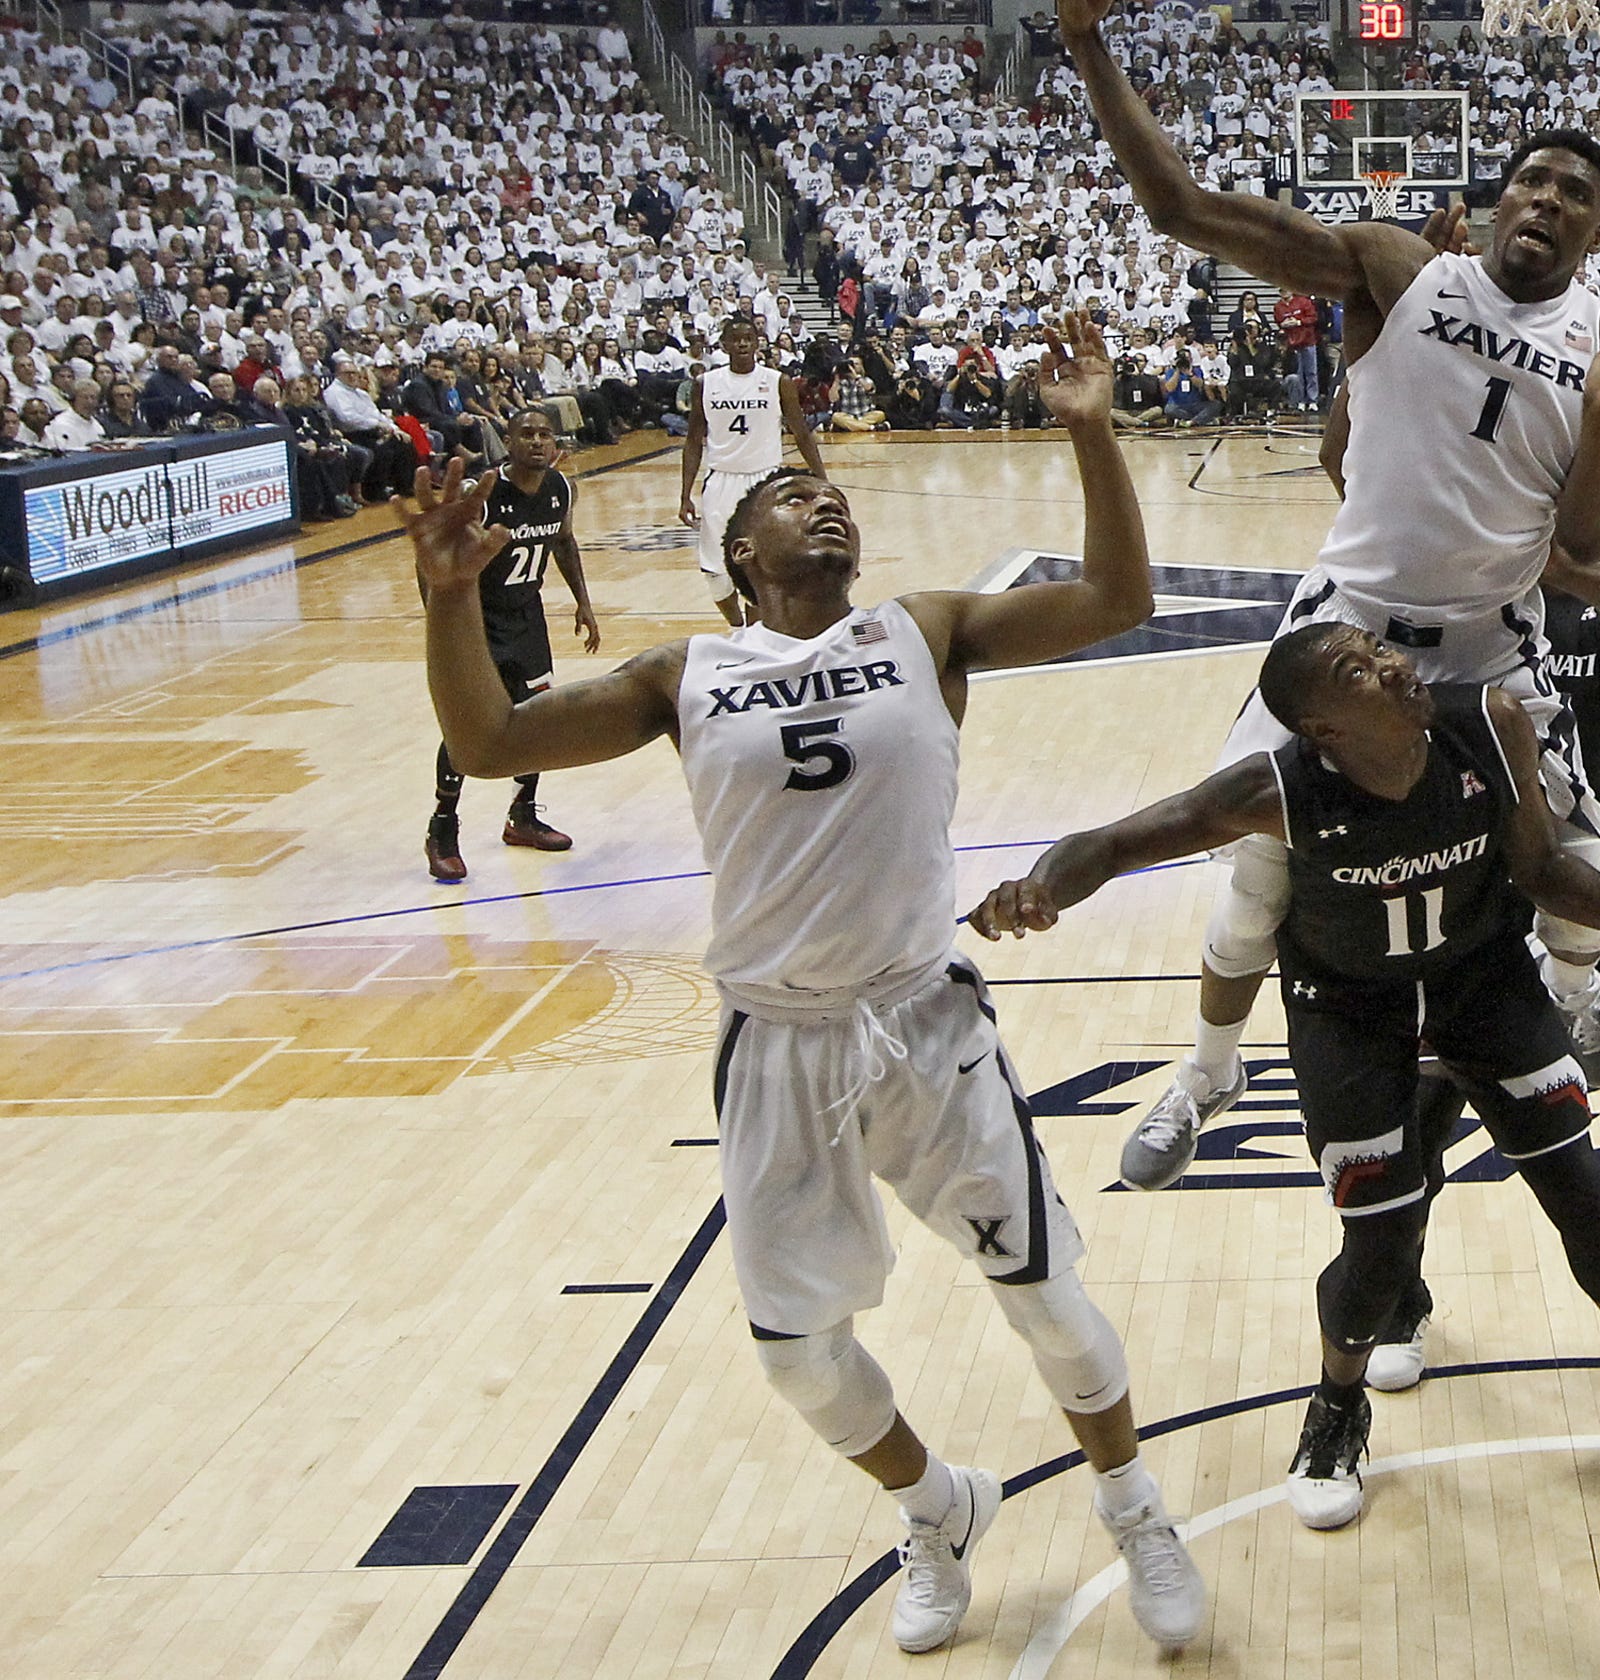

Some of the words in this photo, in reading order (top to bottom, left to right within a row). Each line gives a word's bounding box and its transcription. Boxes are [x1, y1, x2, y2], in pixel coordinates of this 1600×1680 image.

[1360, 4, 1403, 38] 30
[1302, 191, 1438, 212] XAVER
[1418, 308, 1586, 393] XAVIER
[710, 399, 769, 410] XAVIER
[728, 414, 749, 435] 4
[1468, 376, 1514, 444] 1
[62, 461, 210, 541] Woodhull
[219, 481, 286, 517] RICOH
[500, 521, 562, 540] NCINNATI
[504, 543, 544, 586] 21
[705, 660, 909, 718] XAVIER
[779, 716, 856, 792] 5
[1332, 833, 1489, 885] CINCINNATI
[1382, 886, 1448, 956] 11
